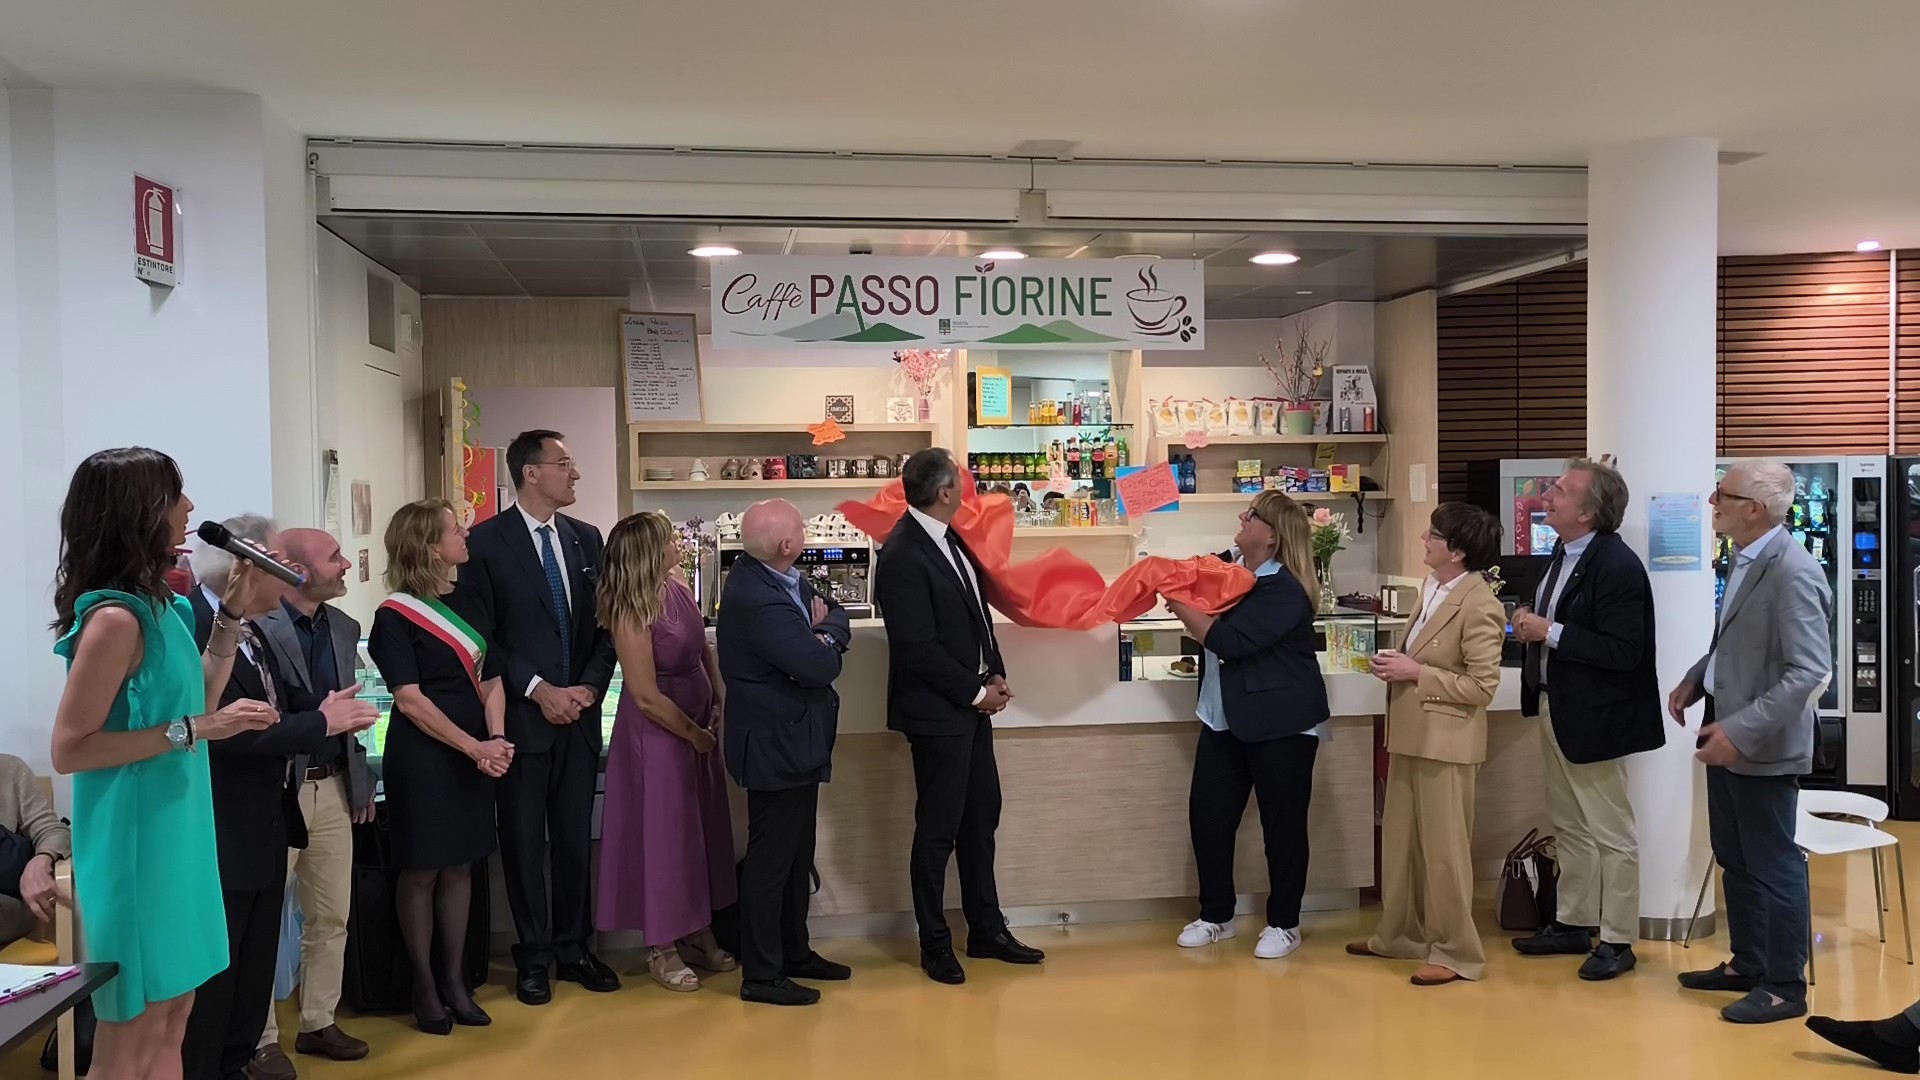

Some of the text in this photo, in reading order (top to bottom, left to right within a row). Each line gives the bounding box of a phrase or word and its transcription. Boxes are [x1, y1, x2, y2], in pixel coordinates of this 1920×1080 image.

[138, 256, 173, 274] ESTINTORE
[721, 273, 1112, 332] Caffè PASSO FIORINE
